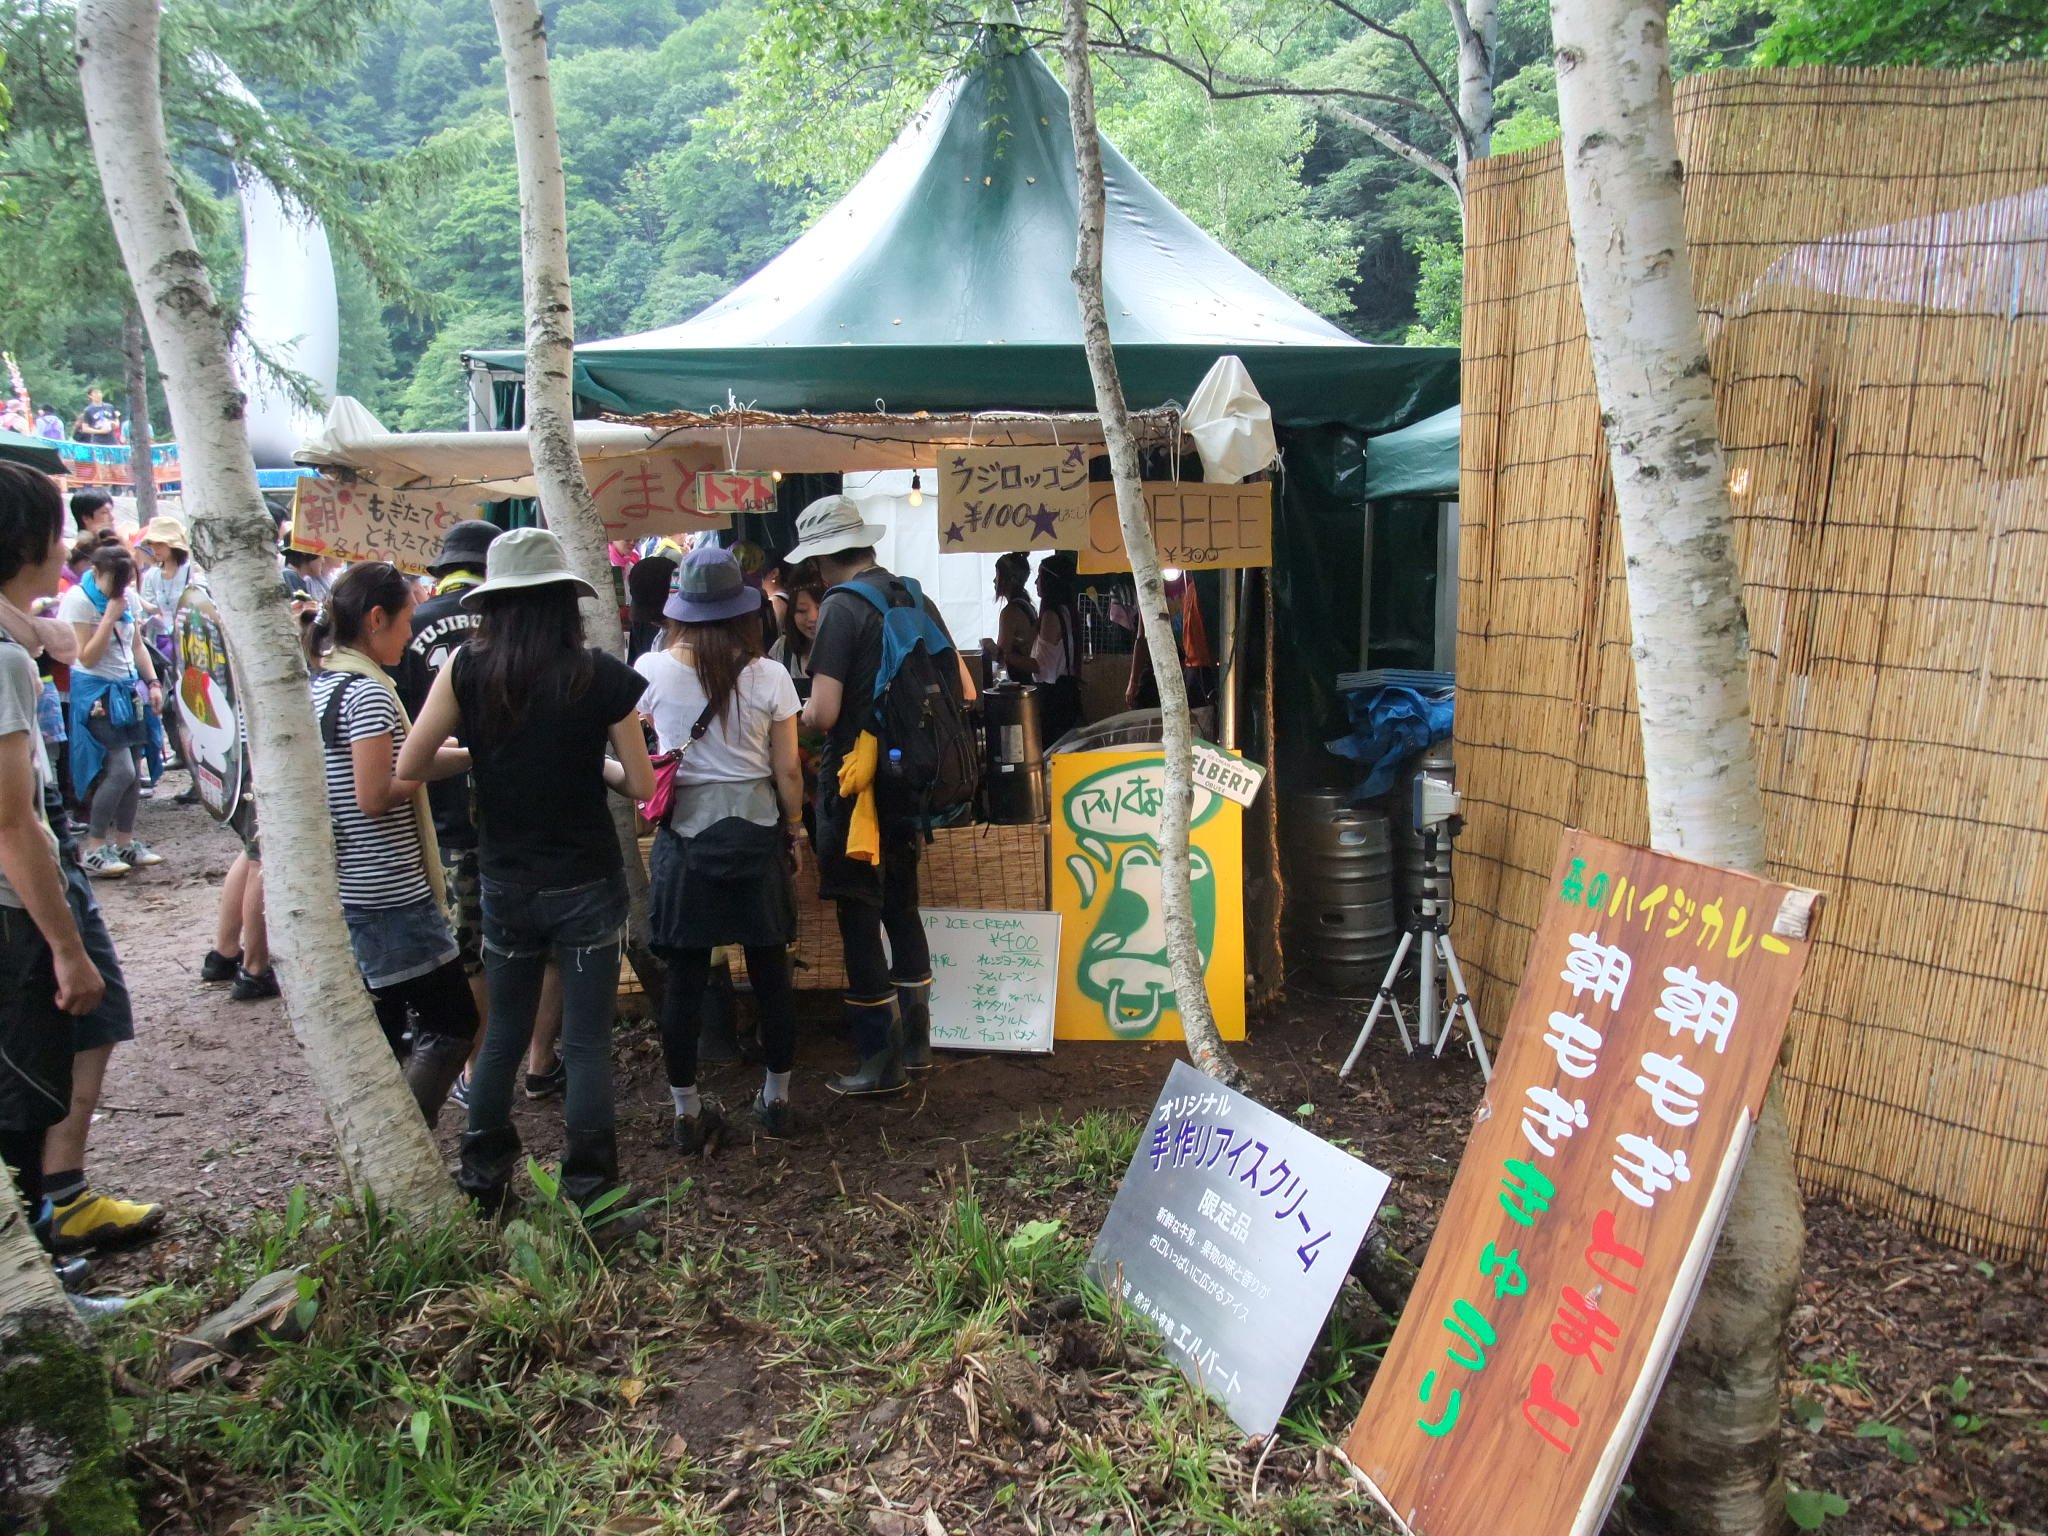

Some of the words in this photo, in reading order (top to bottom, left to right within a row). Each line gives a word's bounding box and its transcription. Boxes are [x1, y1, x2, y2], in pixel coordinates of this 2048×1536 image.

[301, 489, 339, 540] 朝
[704, 475, 773, 510] トマト
[963, 500, 1032, 533] ¥100
[1163, 546, 1219, 564] ¥300
[1192, 754, 1254, 795] ELBERT
[945, 916, 971, 930] ICE
[973, 918, 1025, 931] CREAM
[1558, 857, 1791, 960] 森のハイジカレー
[988, 932, 1039, 952] ¥400
[1159, 1092, 1232, 1122] オリジナル
[1149, 1119, 1332, 1273] 手作りアイスクリーム
[1418, 931, 1632, 1437] 朝もぎきゅうり
[1197, 1187, 1253, 1245] 限定品
[1521, 966, 1739, 1454] 朝もぎとまと
[1149, 1234, 1250, 1324] お口いっぱいに広がるアイス
[1172, 1323, 1241, 1393] エルバート
